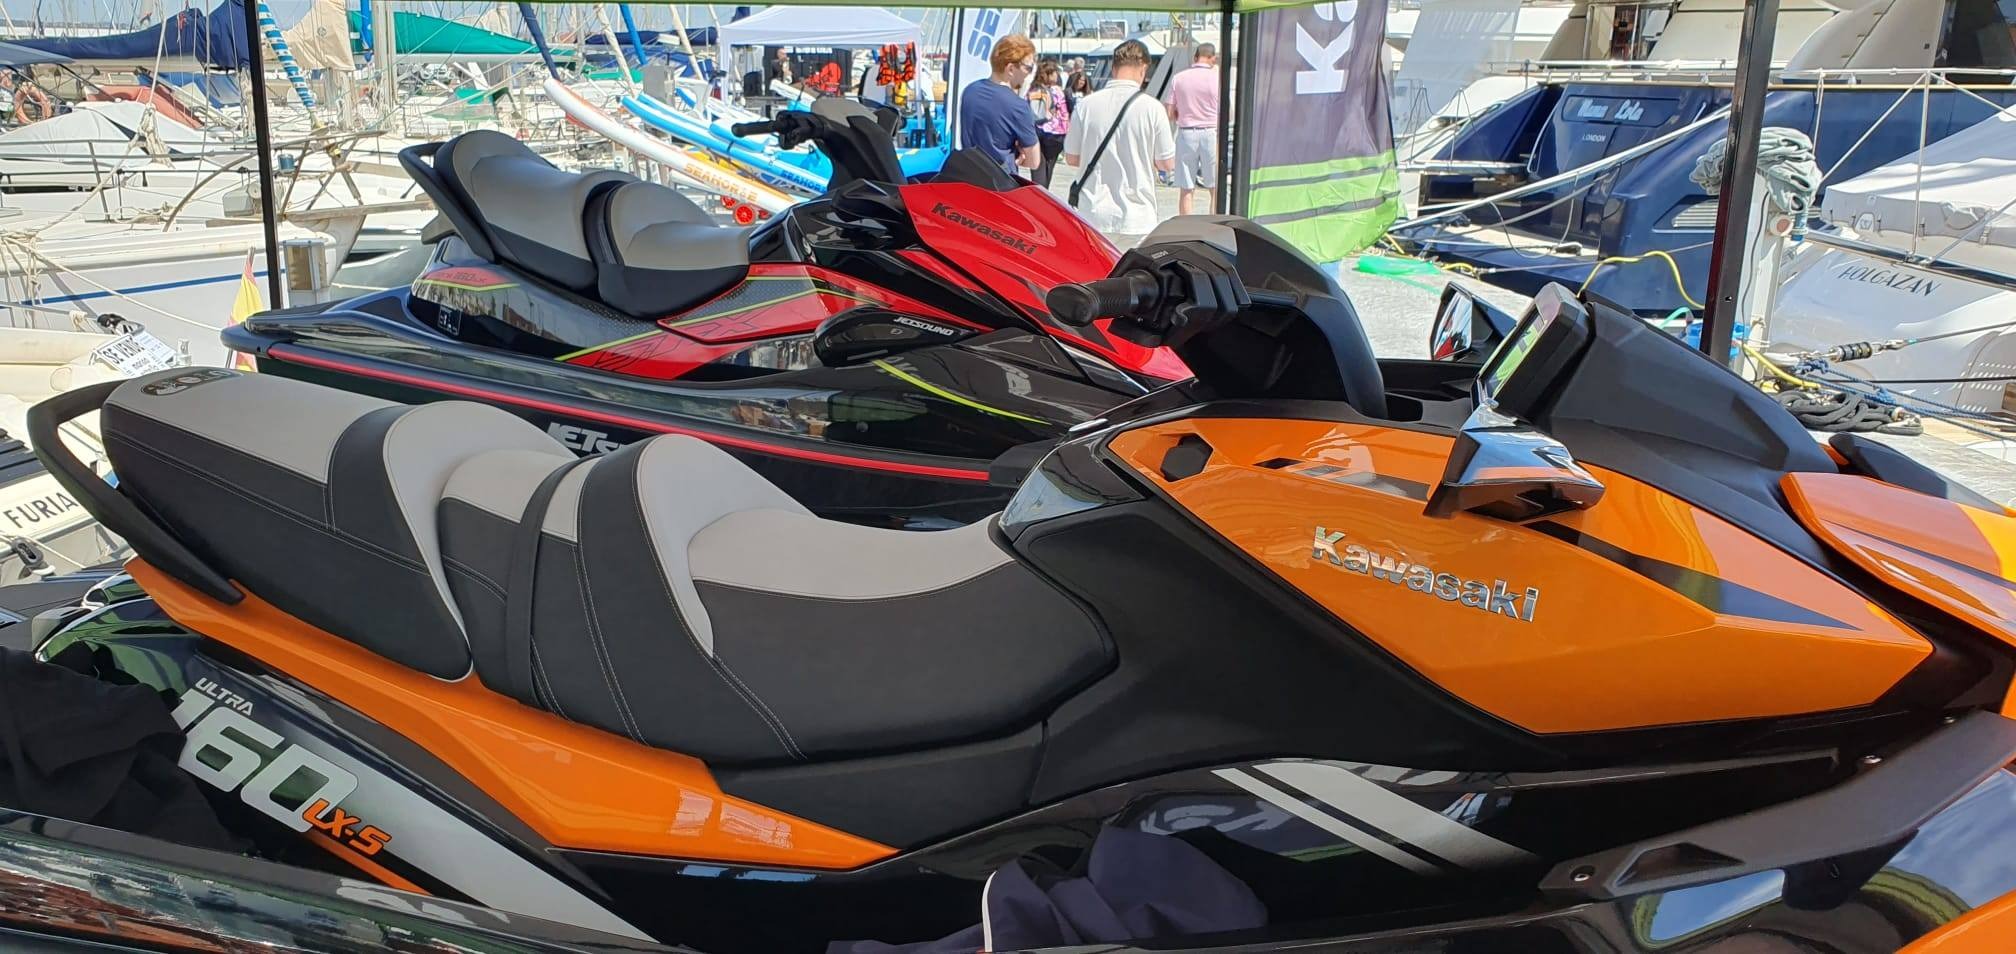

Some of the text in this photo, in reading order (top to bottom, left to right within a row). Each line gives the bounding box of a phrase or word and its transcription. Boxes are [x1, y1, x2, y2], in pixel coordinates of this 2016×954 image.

[967, 8, 1003, 62] SE
[1582, 133, 1607, 143] LONDON
[931, 202, 1038, 255] Kawasaki
[1838, 265, 1942, 297] HOLGAZAN
[893, 316, 955, 337] JETSOUND
[102, 347, 125, 365] SE
[3, 491, 80, 529] FURIA
[1311, 525, 1540, 623] Kawasaki
[194, 676, 255, 717] ULTRA
